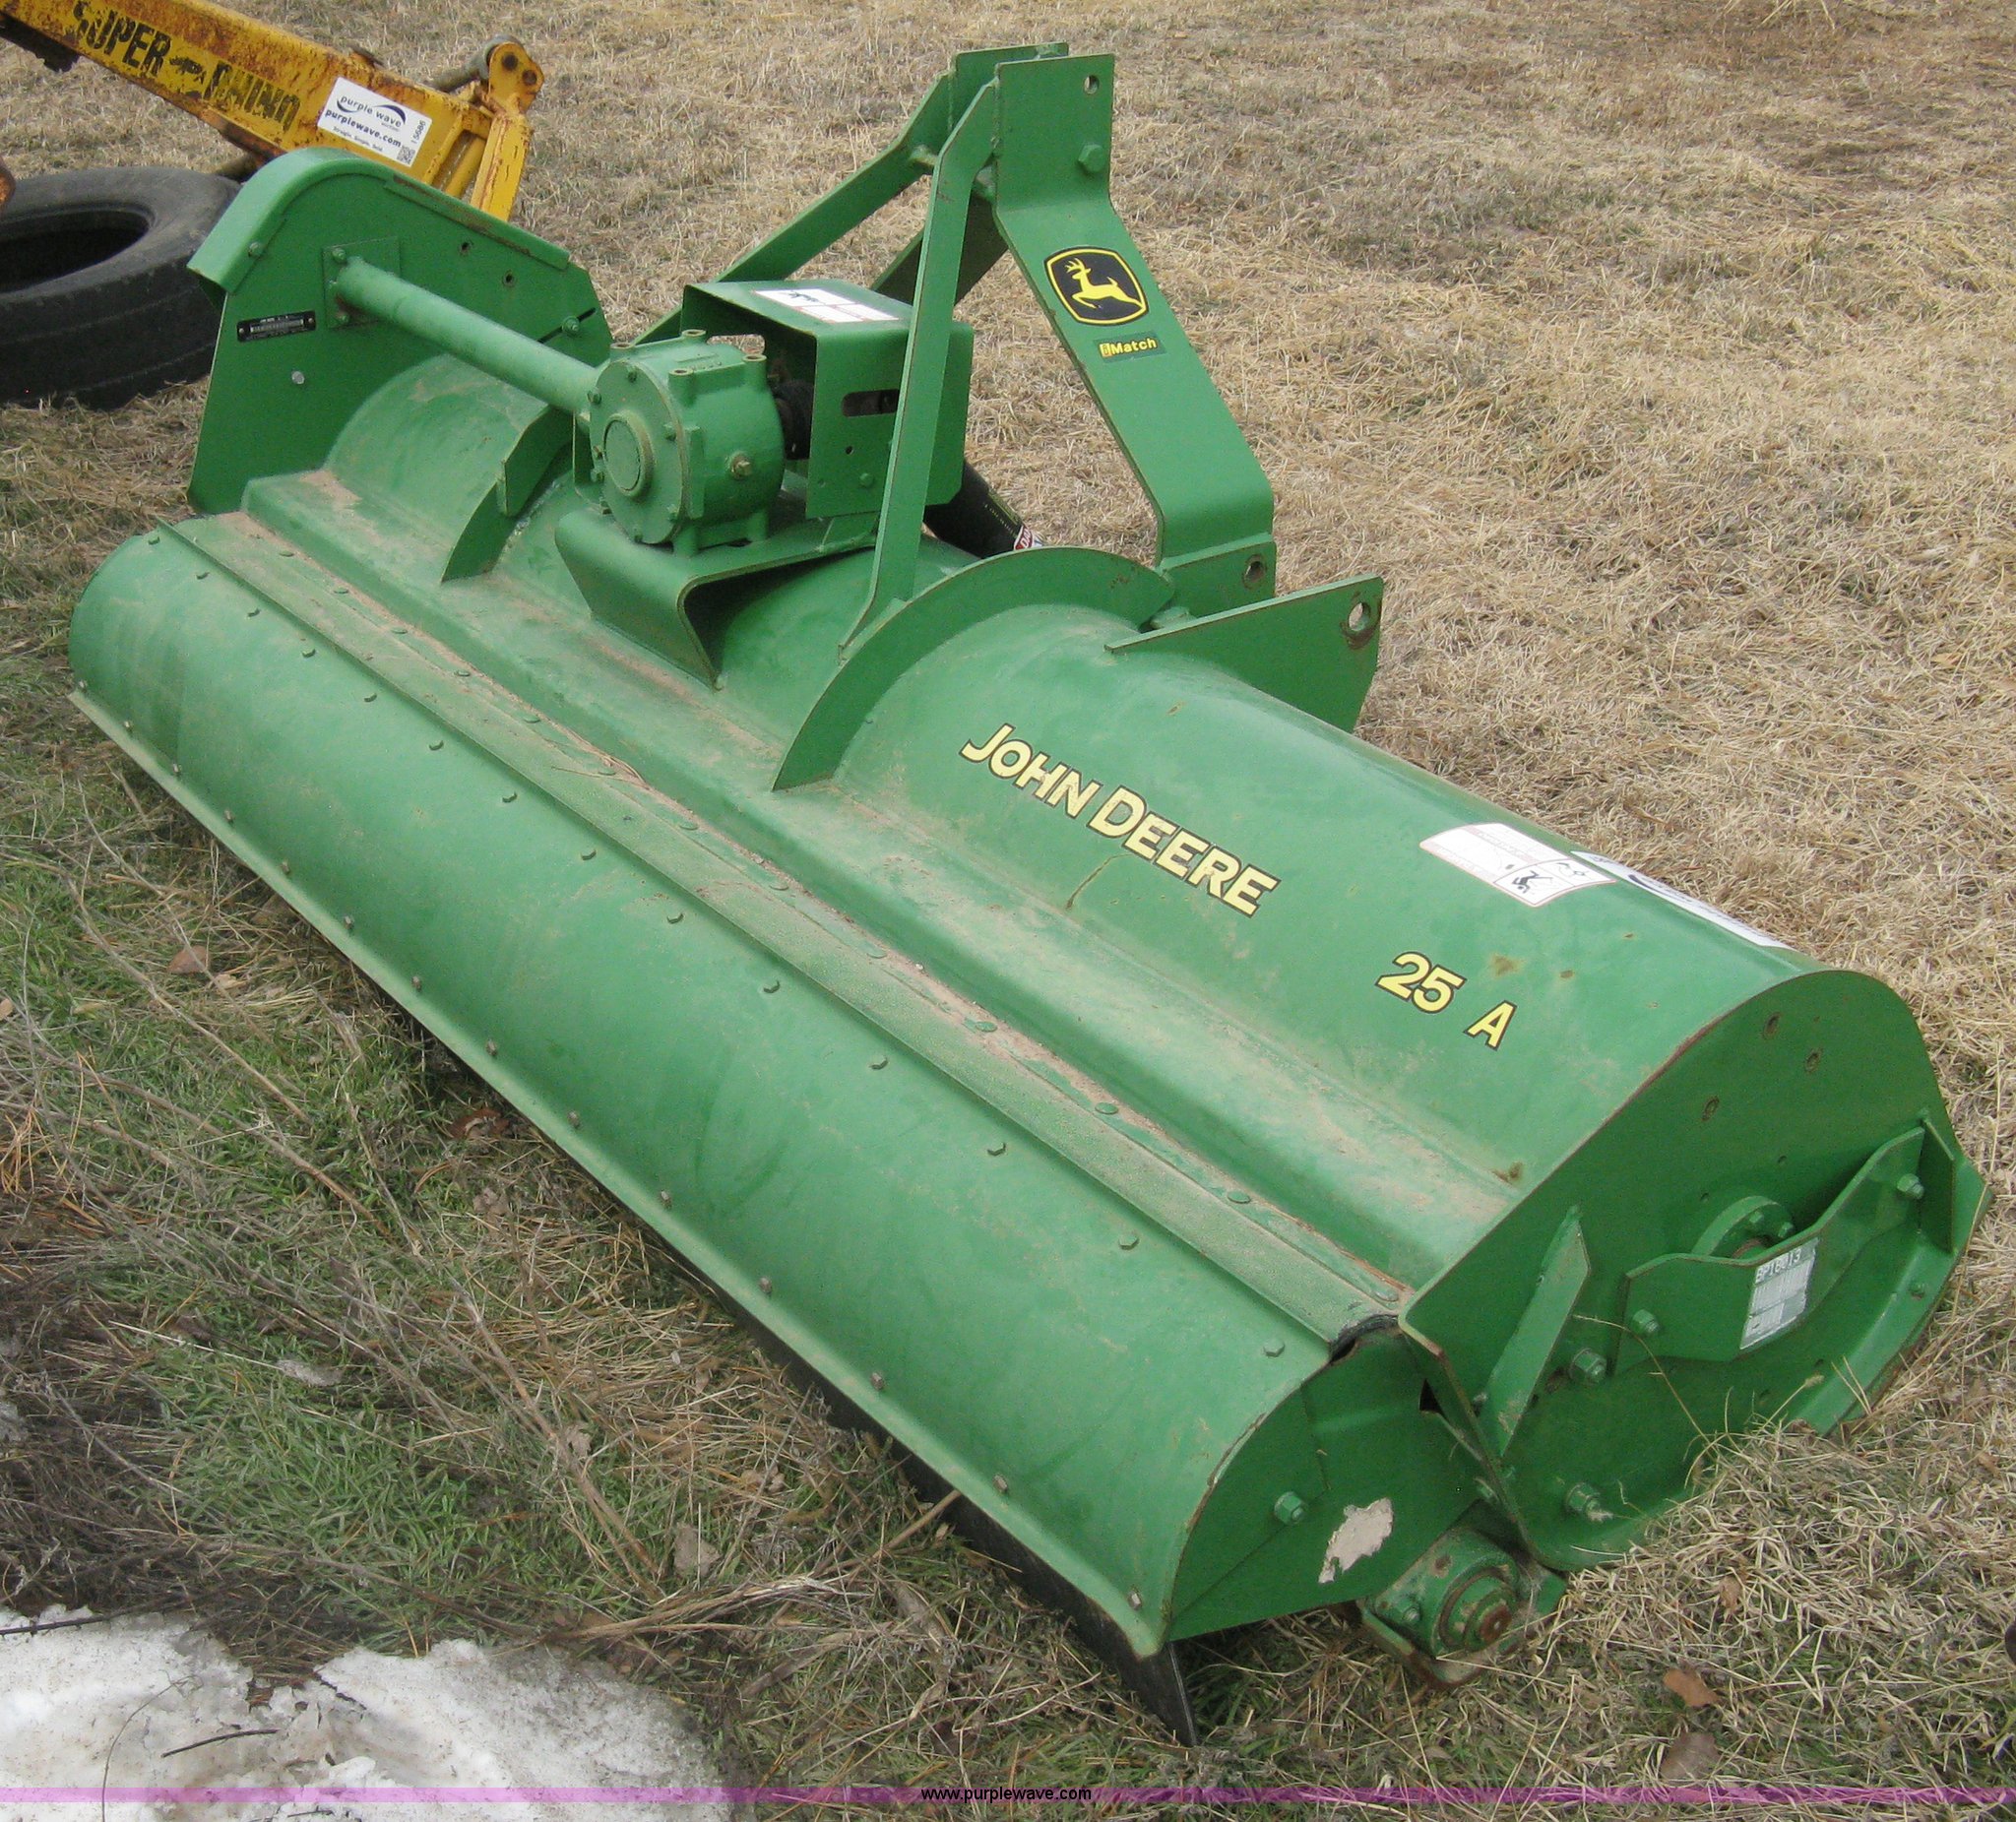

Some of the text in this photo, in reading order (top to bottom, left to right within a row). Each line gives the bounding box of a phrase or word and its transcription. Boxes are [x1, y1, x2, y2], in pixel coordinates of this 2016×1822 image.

[73, 0, 171, 78] SUPER
[325, 109, 402, 148] purplewave.com
[340, 95, 402, 128] purple wave
[959, 723, 1103, 818] JOHN
[1375, 951, 1517, 1050] 25 A
